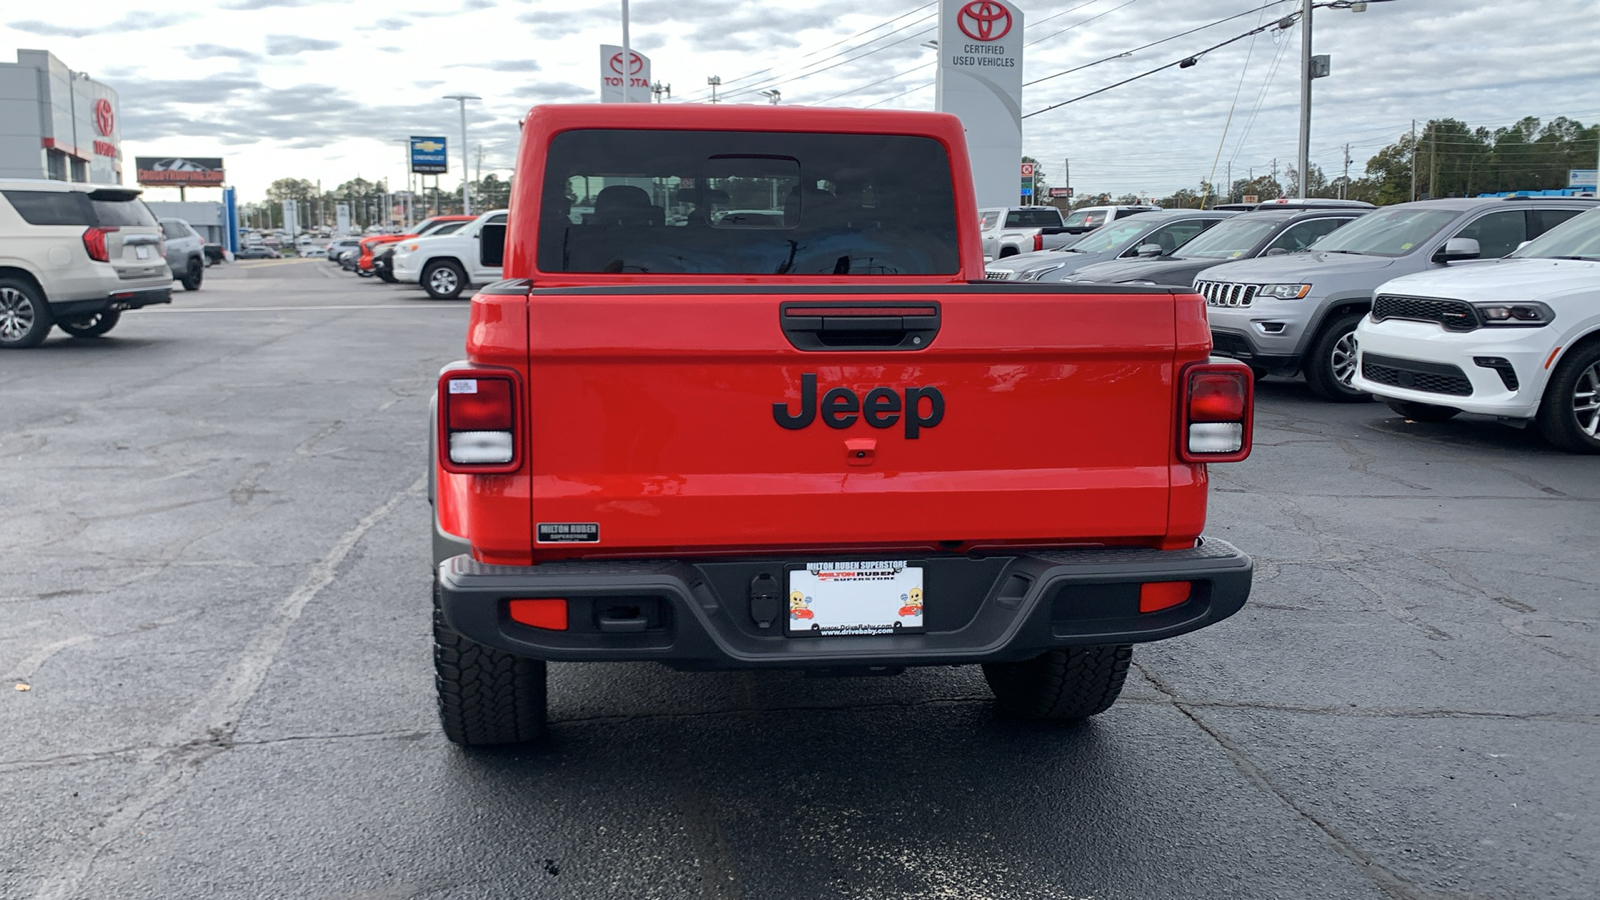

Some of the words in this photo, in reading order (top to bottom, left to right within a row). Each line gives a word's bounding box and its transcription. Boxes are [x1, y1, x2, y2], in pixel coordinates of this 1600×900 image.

[964, 44, 1005, 55] CERTIFIED
[952, 56, 975, 66] USED
[977, 57, 1015, 67] VEHICLES
[772, 373, 945, 440] Jeep
[540, 525, 569, 533] MILTON
[570, 525, 597, 533] RUBEN
[806, 562, 834, 571] MILTON
[834, 561, 859, 570] RUBEN
[860, 560, 908, 569] SUPERSTORE
[821, 628, 894, 636] www.drivebaby.com
